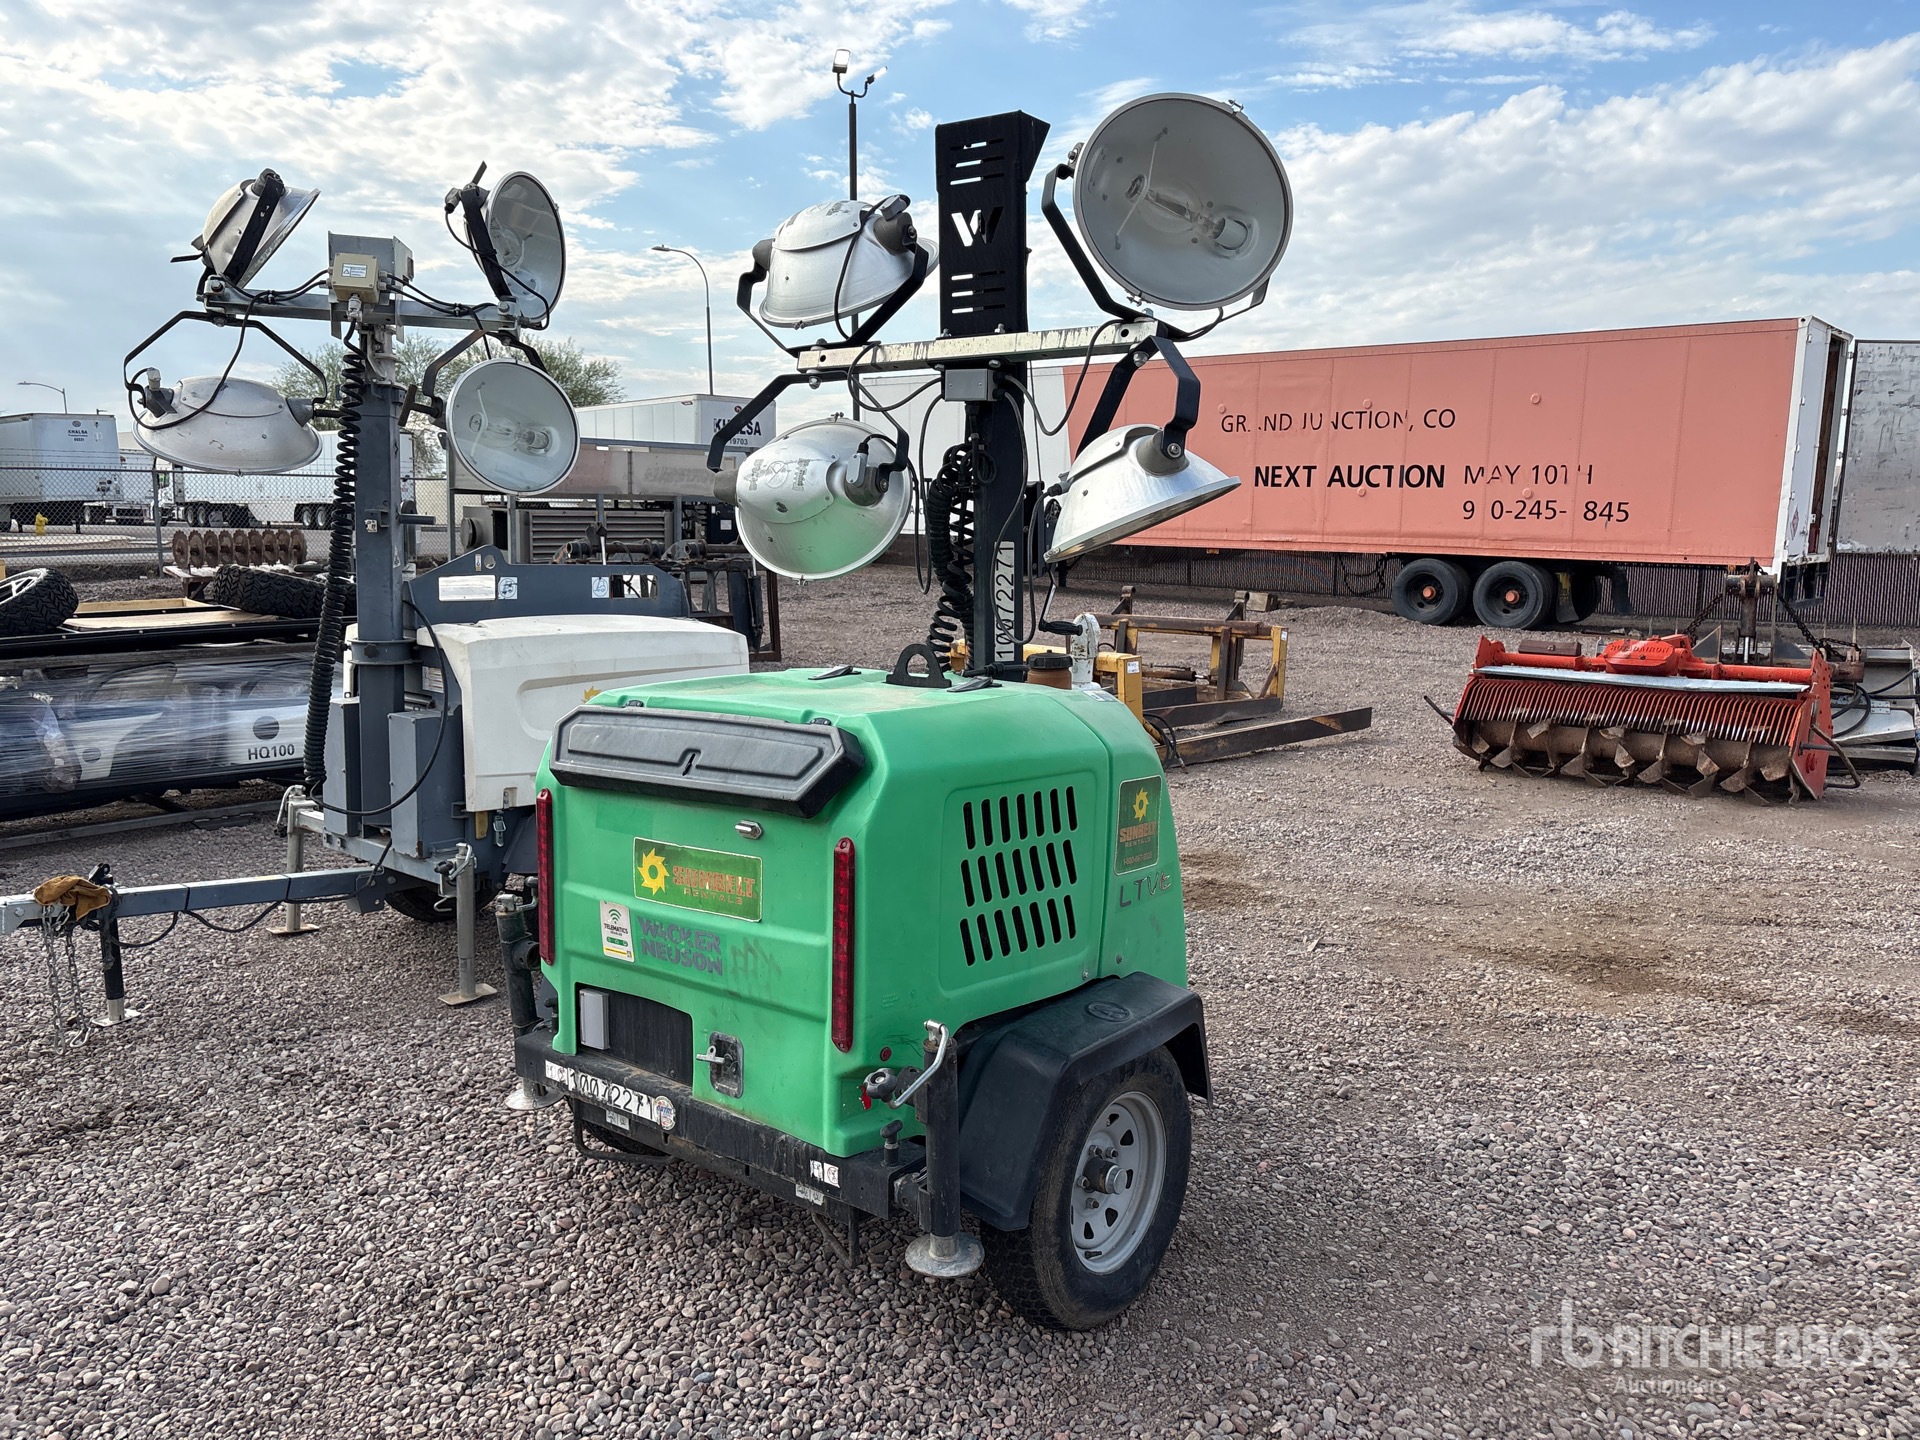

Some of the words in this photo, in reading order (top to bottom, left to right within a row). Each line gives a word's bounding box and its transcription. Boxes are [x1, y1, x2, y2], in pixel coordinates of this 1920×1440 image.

[1220, 414, 1293, 433] GRND
[1423, 409, 1456, 429] CO
[1254, 465, 1317, 488] NEXT
[1326, 464, 1446, 488] AUCTION
[1464, 464, 1521, 485] MAY
[248, 743, 295, 761] HQ100
[1119, 820, 1157, 842] SUNBELT
[672, 866, 755, 898] SUNBELT
[683, 887, 743, 905] RENTALS
[604, 923, 628, 935] TELEMATICS
[641, 937, 723, 977] NEUSON
